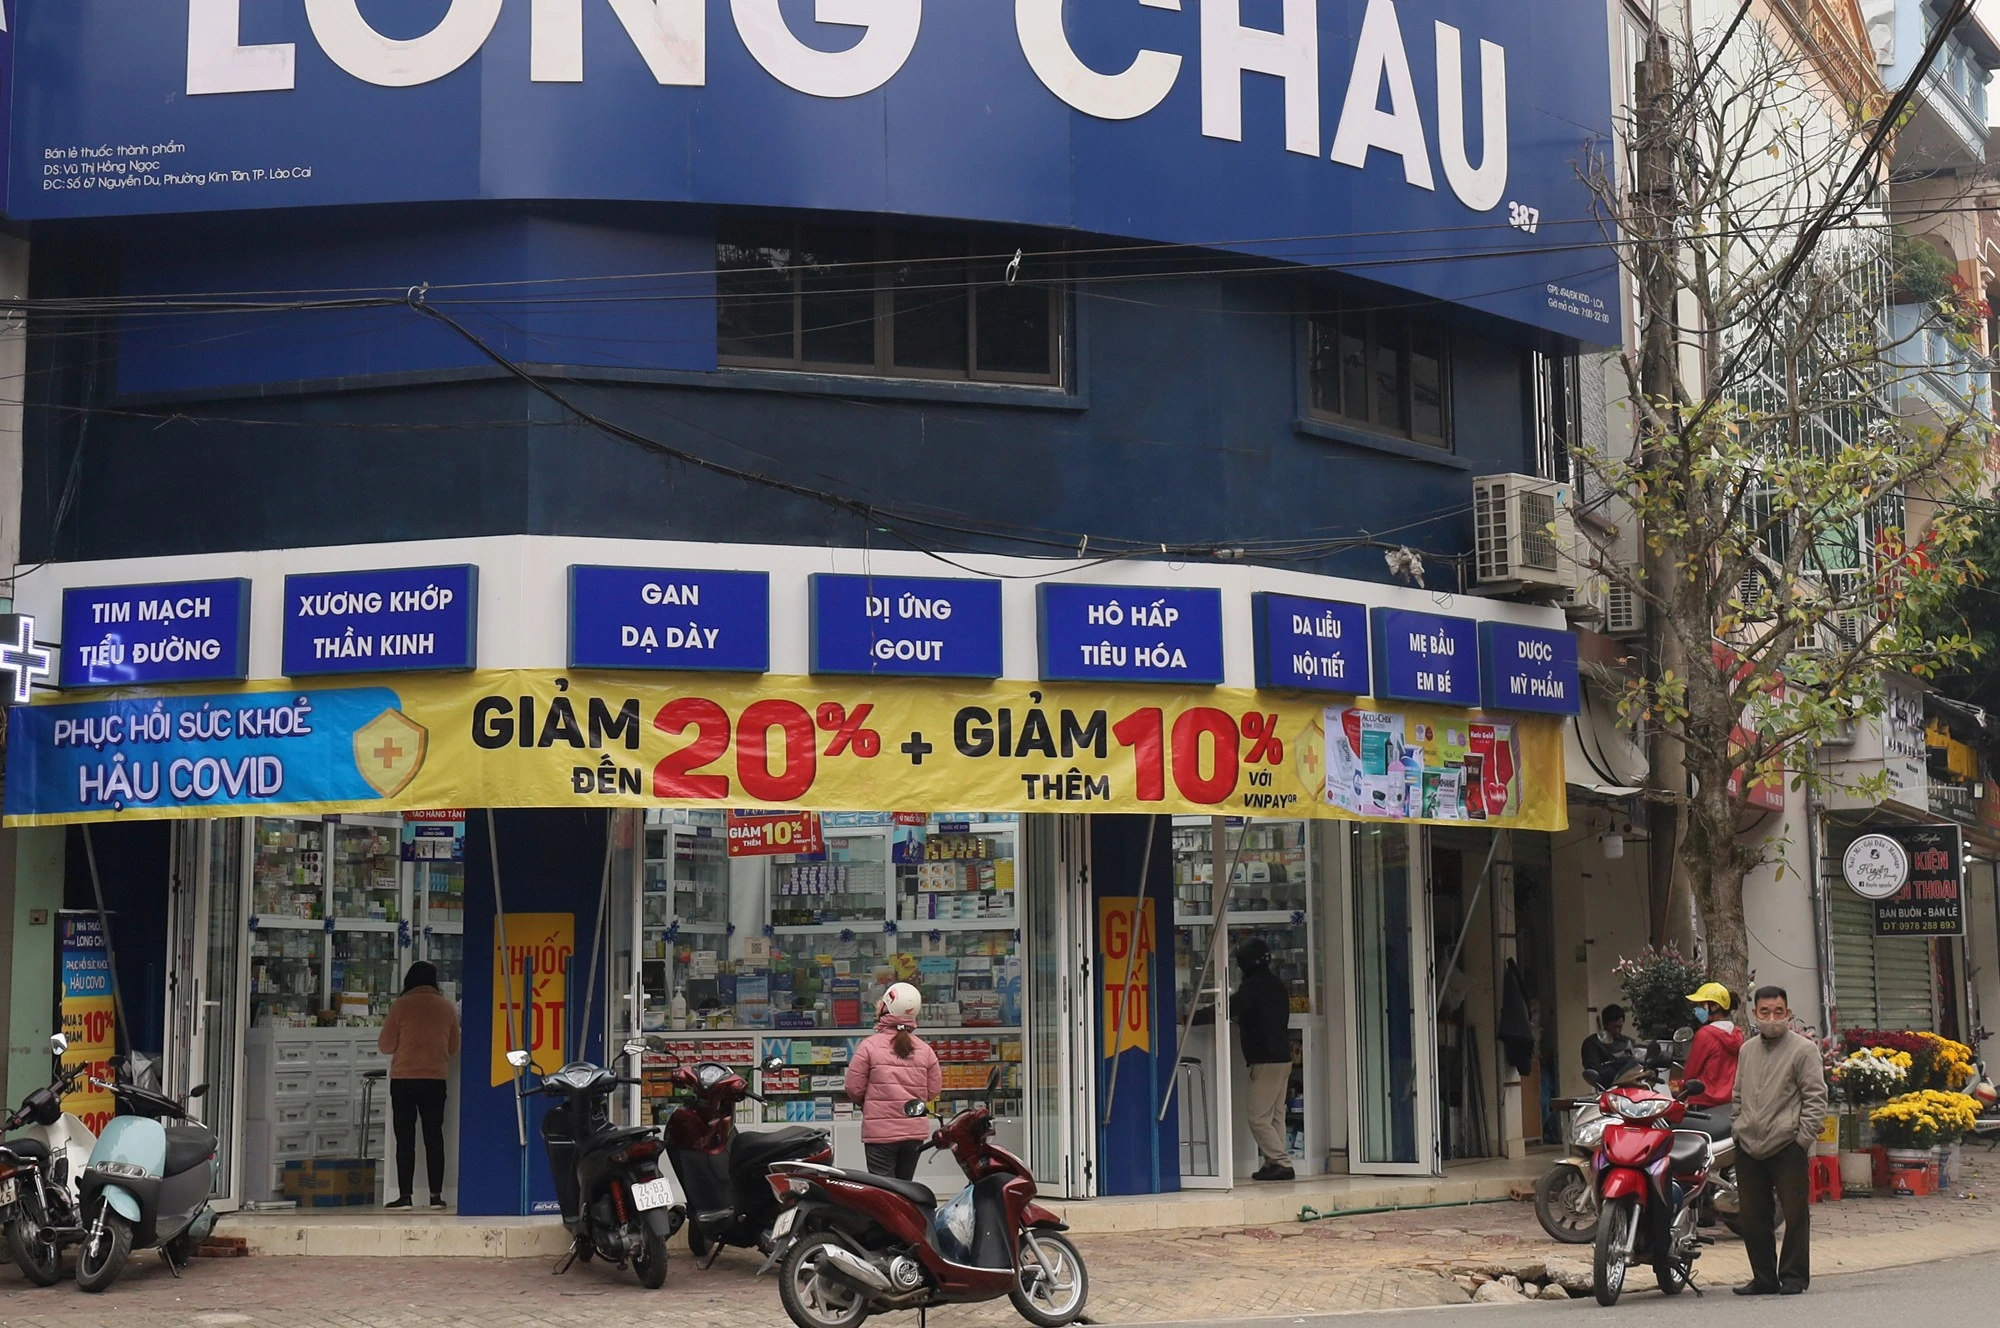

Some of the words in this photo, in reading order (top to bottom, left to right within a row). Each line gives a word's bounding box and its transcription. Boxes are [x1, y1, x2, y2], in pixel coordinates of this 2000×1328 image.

[45, 149, 65, 159] Bán
[68, 147, 78, 158] lẻ
[81, 143, 113, 158] thuốc
[117, 142, 149, 157] thành
[152, 140, 185, 156] phẩm
[63, 162, 78, 174] Vũ
[81, 162, 95, 176] Thị
[97, 160, 126, 176] Hồng
[130, 159, 160, 173] Ngọc
[67, 175, 81, 189] Số
[84, 177, 96, 188] 67
[98, 173, 141, 190] Nguyễn
[164, 170, 206, 186] Phường
[208, 172, 228, 183] Kim
[252, 169, 268, 180] TP.
[269, 167, 290, 180] Lào
[291, 167, 312, 179] Cai
[1508, 201, 1539, 234] 387
[299, 592, 382, 617] XƯƠNG
[390, 583, 453, 614] KHỚP
[641, 583, 699, 606] GAN
[866, 597, 891, 625] DỊ
[898, 591, 951, 621] ỨNG
[93, 602, 130, 624] TIM
[138, 597, 211, 627] MẠCH
[1088, 600, 1123, 626] HÔ
[1131, 597, 1179, 629] HẤP
[1292, 614, 1312, 637] DA
[1315, 608, 1341, 639] LIỄU
[79, 634, 125, 667] TIỂU
[132, 634, 221, 665] ĐƯỜNG
[313, 626, 373, 660] THẦN
[381, 633, 435, 657] KINH
[621, 625, 658, 655] DẠ
[666, 621, 719, 650] DÀY
[874, 639, 943, 662] GOUT
[1409, 632, 1428, 658] MẸ
[1431, 629, 1455, 657] BẦU
[1518, 638, 1553, 668] DƯỢC
[1080, 639, 1127, 667] TIÊU
[1134, 640, 1188, 669] HÓA
[1292, 648, 1317, 680] NỘI
[1318, 650, 1345, 680] TIẾT
[1416, 671, 1436, 693] EM
[1438, 668, 1453, 694] BÉ
[1510, 671, 1529, 697] MỸ
[1531, 669, 1564, 700] PHẨM
[54, 714, 123, 751] PHỤC
[130, 698, 171, 741] HỒI
[178, 704, 232, 740] SỨC
[239, 697, 313, 737] KHOẺ
[472, 678, 640, 750] GIẢM
[652, 696, 881, 801] 20%
[901, 731, 932, 766] +
[954, 690, 1108, 759] GIẢM
[1112, 706, 1284, 805] 10%
[79, 752, 160, 810] HẬU
[169, 755, 283, 800] COVID
[571, 754, 642, 795] ĐẾN
[1021, 767, 1110, 801] THÊM
[1249, 768, 1272, 787] VỚI
[729, 823, 761, 839] GIẢM
[762, 821, 803, 845] 10%
[743, 839, 761, 847] THÊM
[1914, 847, 1949, 874] KIỆN
[1913, 880, 1957, 903] THOẠI
[1880, 906, 1896, 918] BÁN
[1898, 904, 1921, 917] BUÔN
[1928, 905, 1945, 917] BÁN
[76, 935, 93, 947] LONG
[1105, 900, 1150, 960] GIÁ
[497, 931, 572, 976] THUỐC
[86, 975, 105, 990] COVID
[77, 1013, 82, 1026] 3
[84, 1011, 114, 1043] 10%
[499, 978, 566, 1051] TỐT
[639, 1181, 664, 1197] 24-B3
[639, 1192, 670, 1209] 124.02
